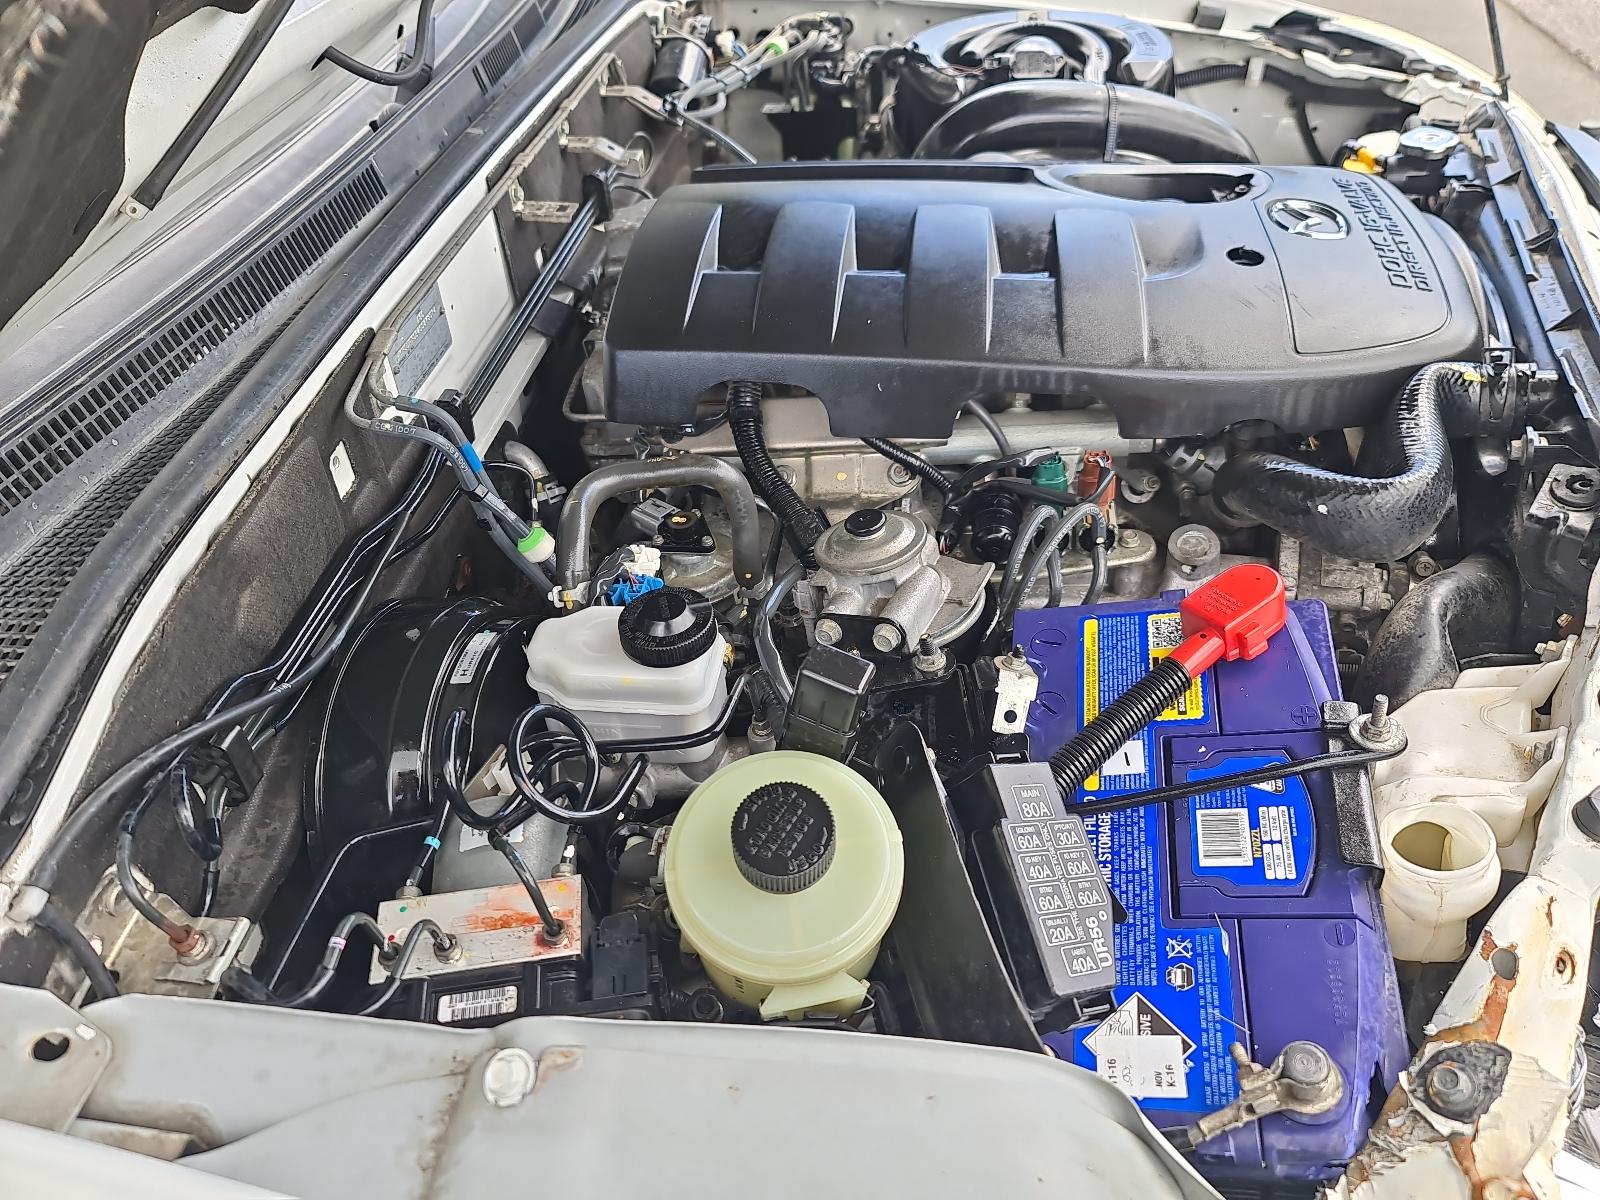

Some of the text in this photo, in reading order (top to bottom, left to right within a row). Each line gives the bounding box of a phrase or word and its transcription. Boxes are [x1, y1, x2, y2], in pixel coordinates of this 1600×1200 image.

[1332, 176, 1413, 290] DOHC 16-VALVE
[1355, 180, 1433, 292] DIRECT INJECTION
[1020, 789, 1040, 797] MAIN
[1022, 802, 1051, 818] 80A
[1017, 835, 1042, 849] 60A
[1056, 831, 1080, 846] 30A
[1251, 827, 1262, 858] N70ZZL
[1097, 812, 1112, 888] TRIC STORAGE
[1029, 865, 1051, 879] 40A
[1067, 860, 1090, 875] 60A
[1038, 895, 1063, 910] 60A
[1077, 891, 1101, 905] 60A
[1071, 910, 1081, 924] THE
[1142, 916, 1148, 924] OR
[1049, 928, 1075, 943] 20A
[1086, 916, 1113, 968] UR56
[1071, 958, 1097, 972] 40A
[1128, 959, 1136, 986] BATTERY
[1140, 1013, 1151, 1036] SIVE
[1165, 1064, 1176, 1087] K-16
